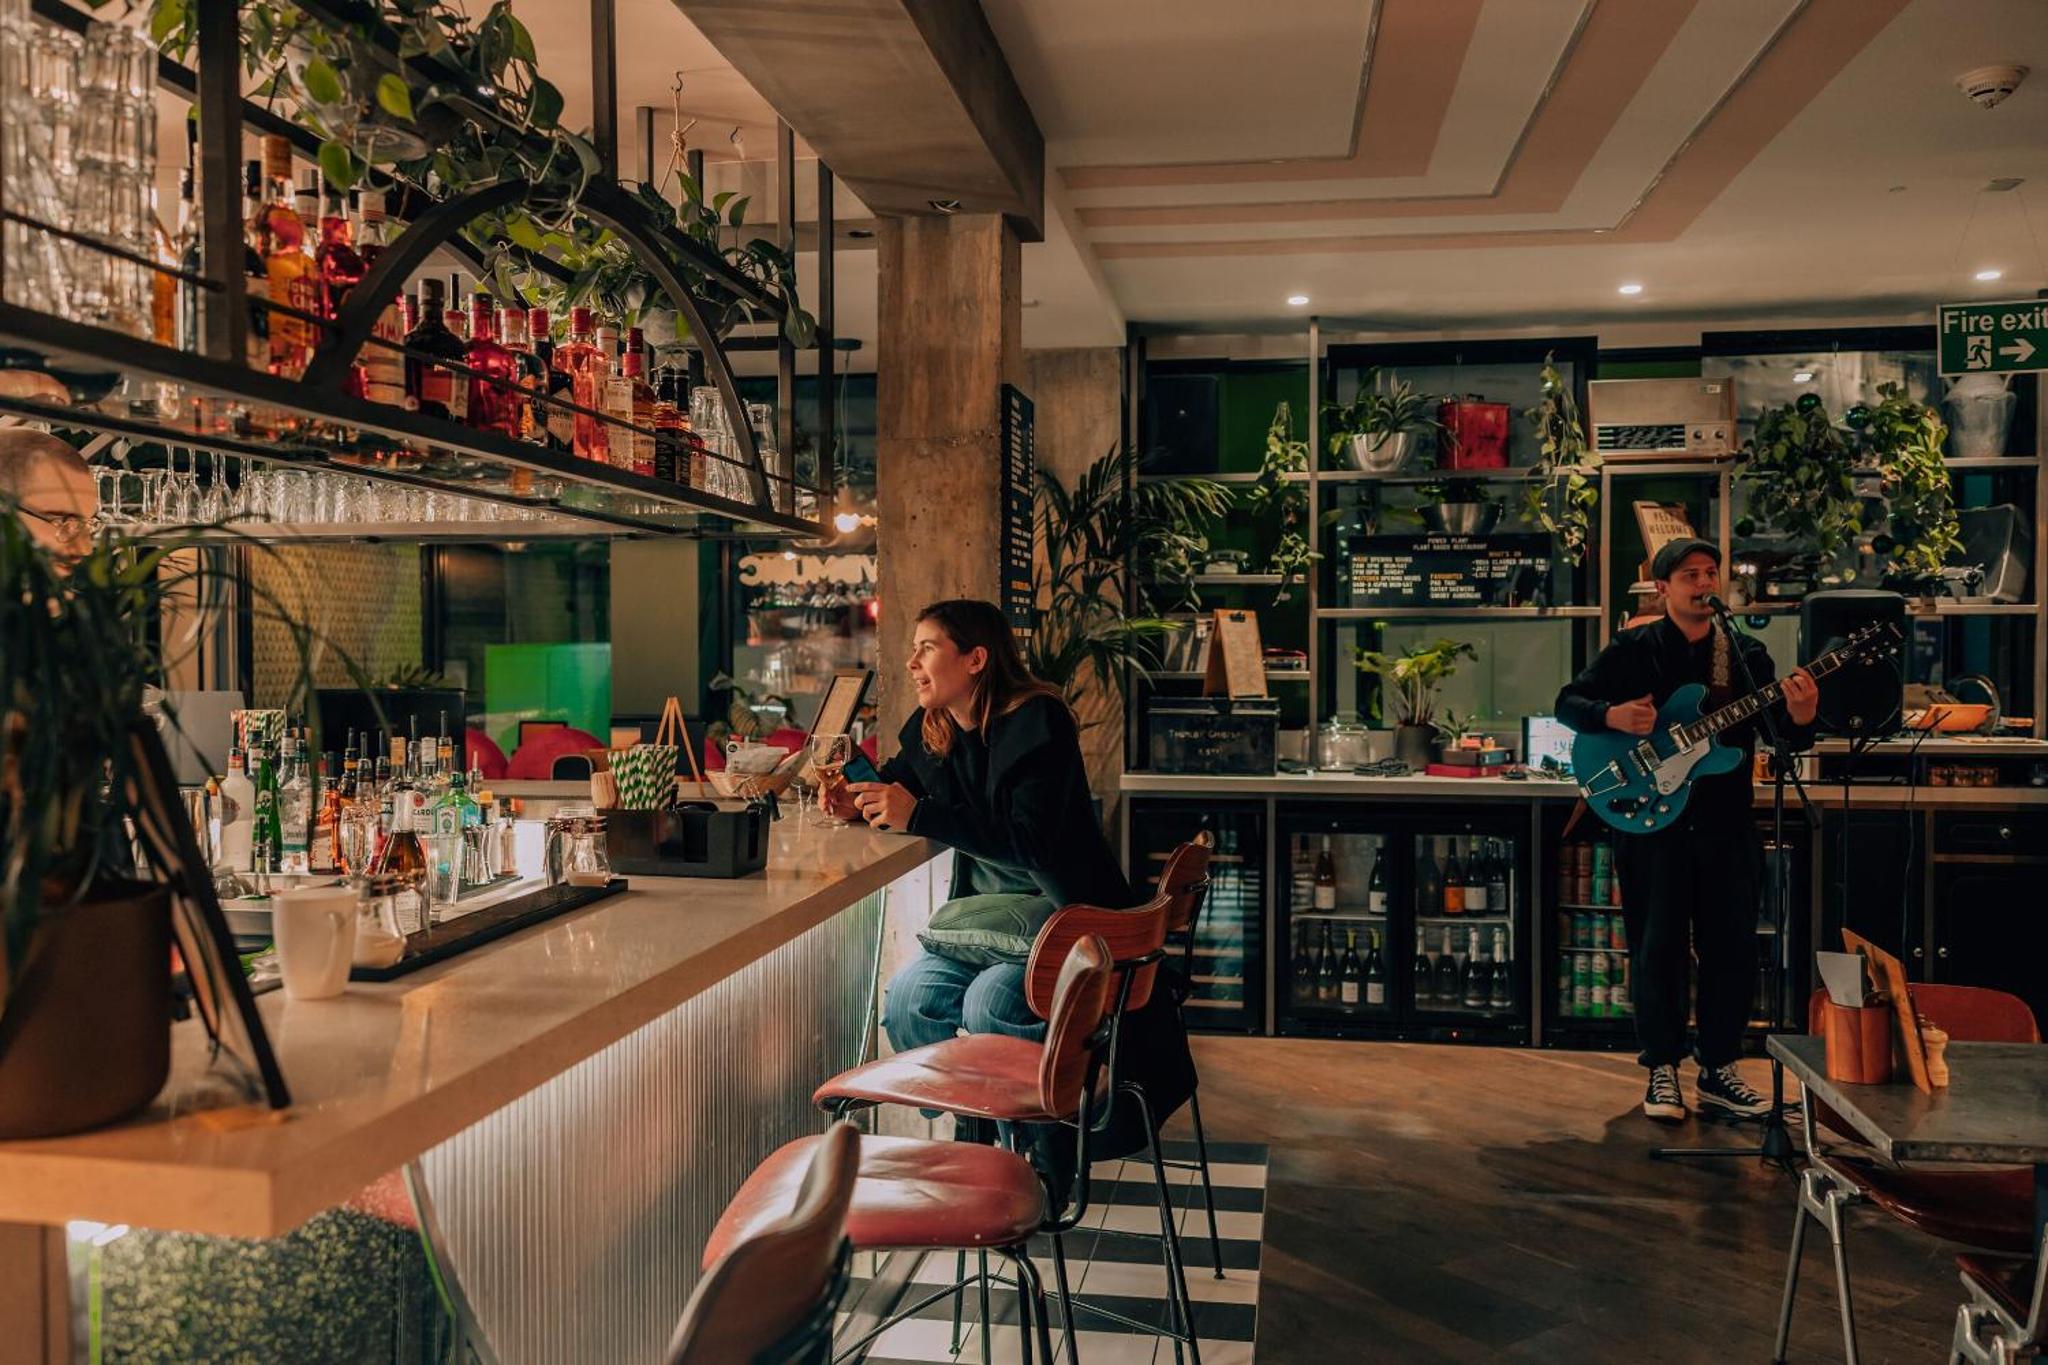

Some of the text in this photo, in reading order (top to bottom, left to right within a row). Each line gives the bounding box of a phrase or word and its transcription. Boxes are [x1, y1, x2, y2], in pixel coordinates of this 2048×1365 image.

[1943, 306, 2048, 334] Fire exit
[1412, 543, 1431, 551] PLANT
